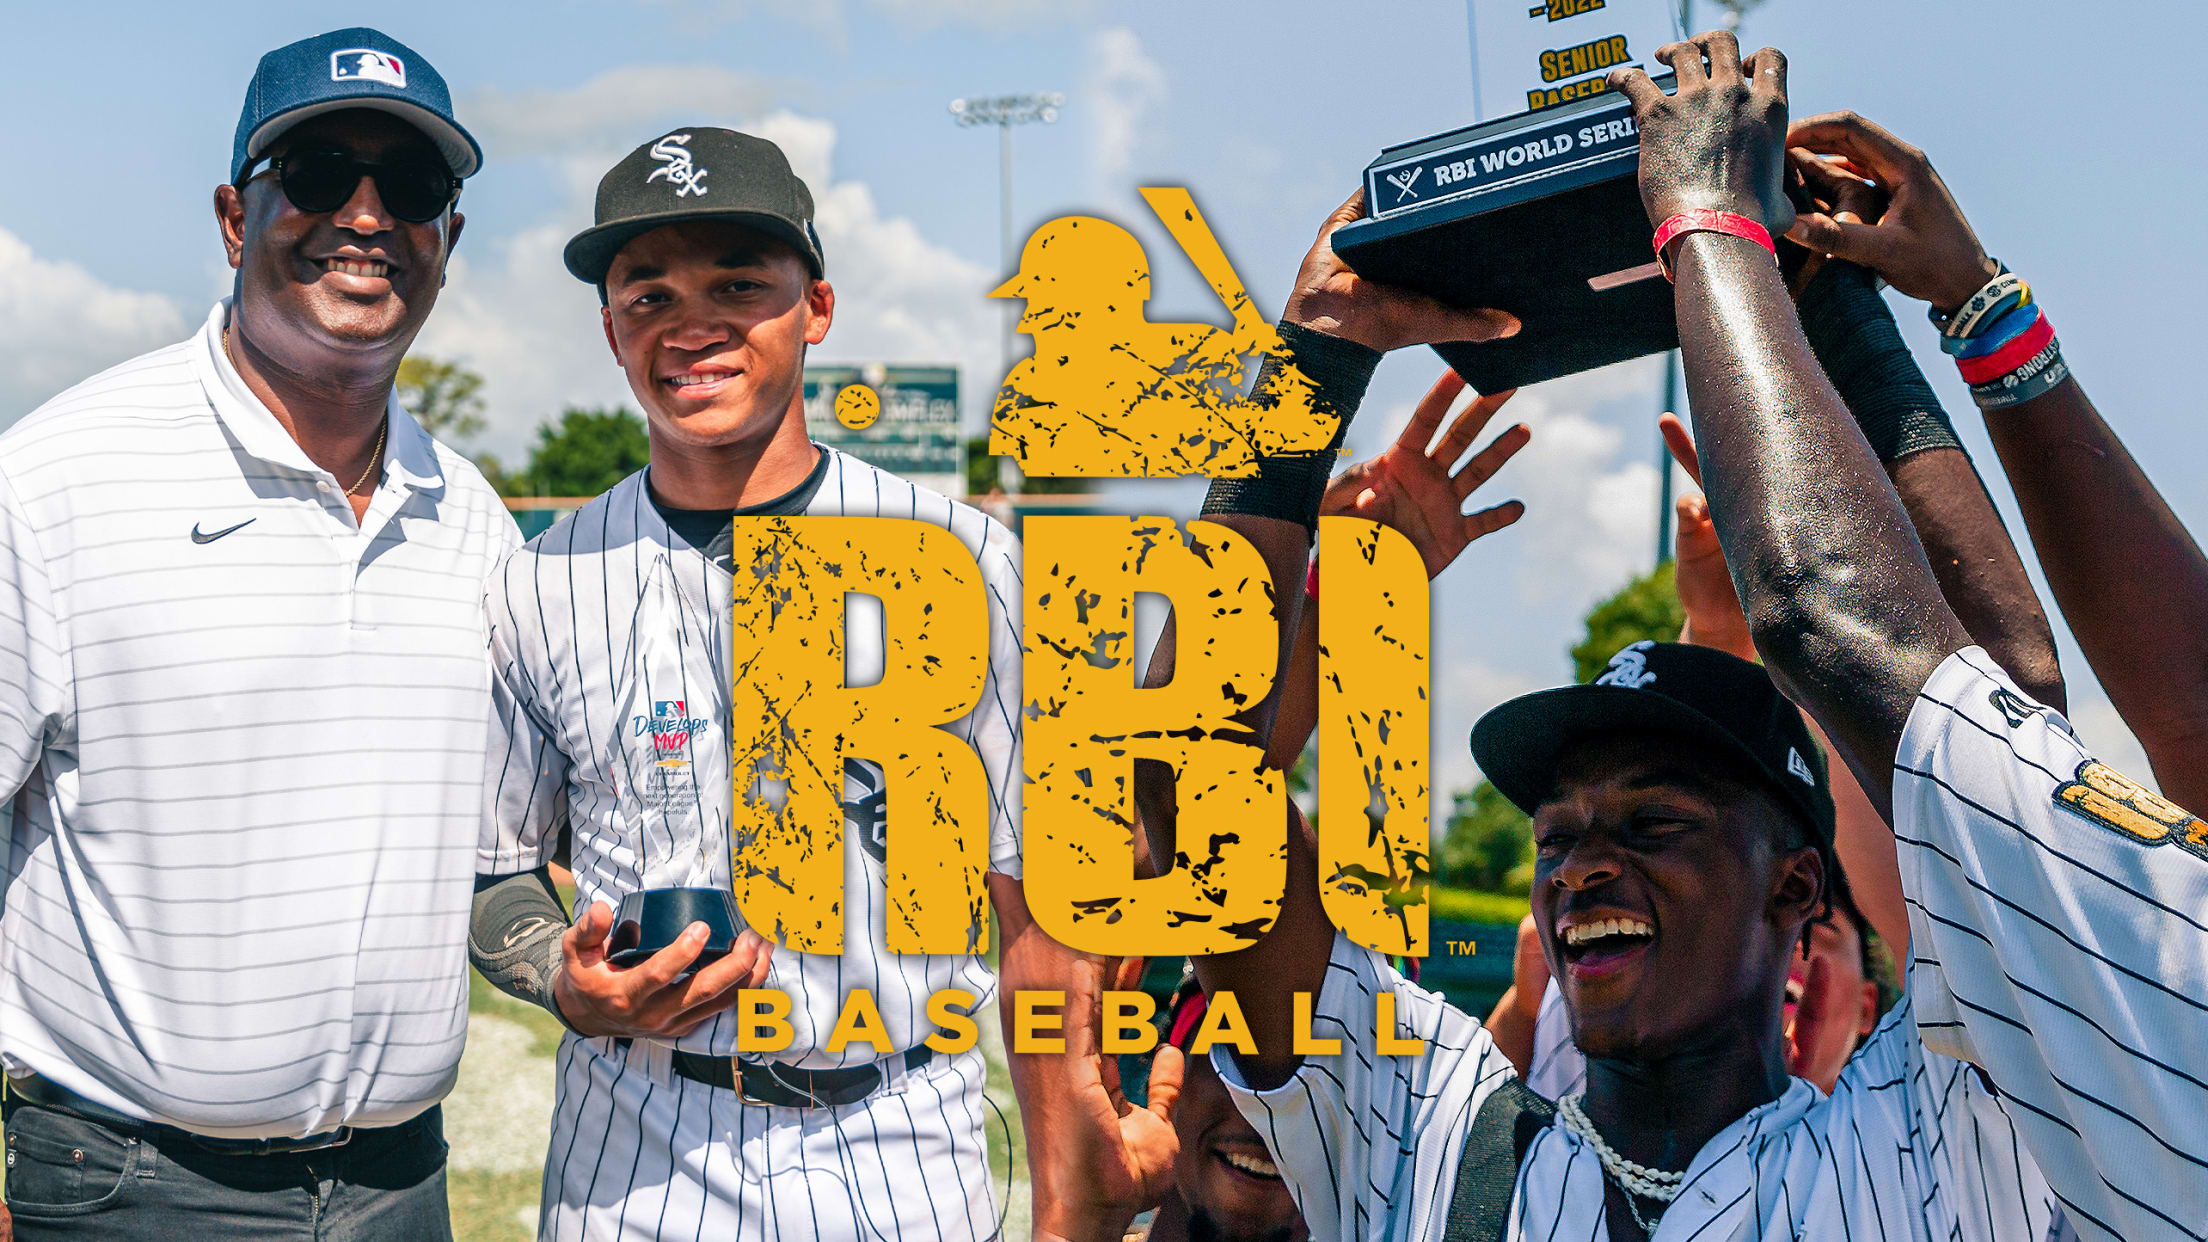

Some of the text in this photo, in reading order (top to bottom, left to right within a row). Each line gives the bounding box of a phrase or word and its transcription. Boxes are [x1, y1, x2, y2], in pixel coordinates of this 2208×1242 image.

[1540, 36, 1629, 82] SENIOR
[1433, 115, 1640, 187] RBI WORLD SERI
[633, 715, 709, 737] DEVELOPS
[654, 732, 689, 751] MVP
